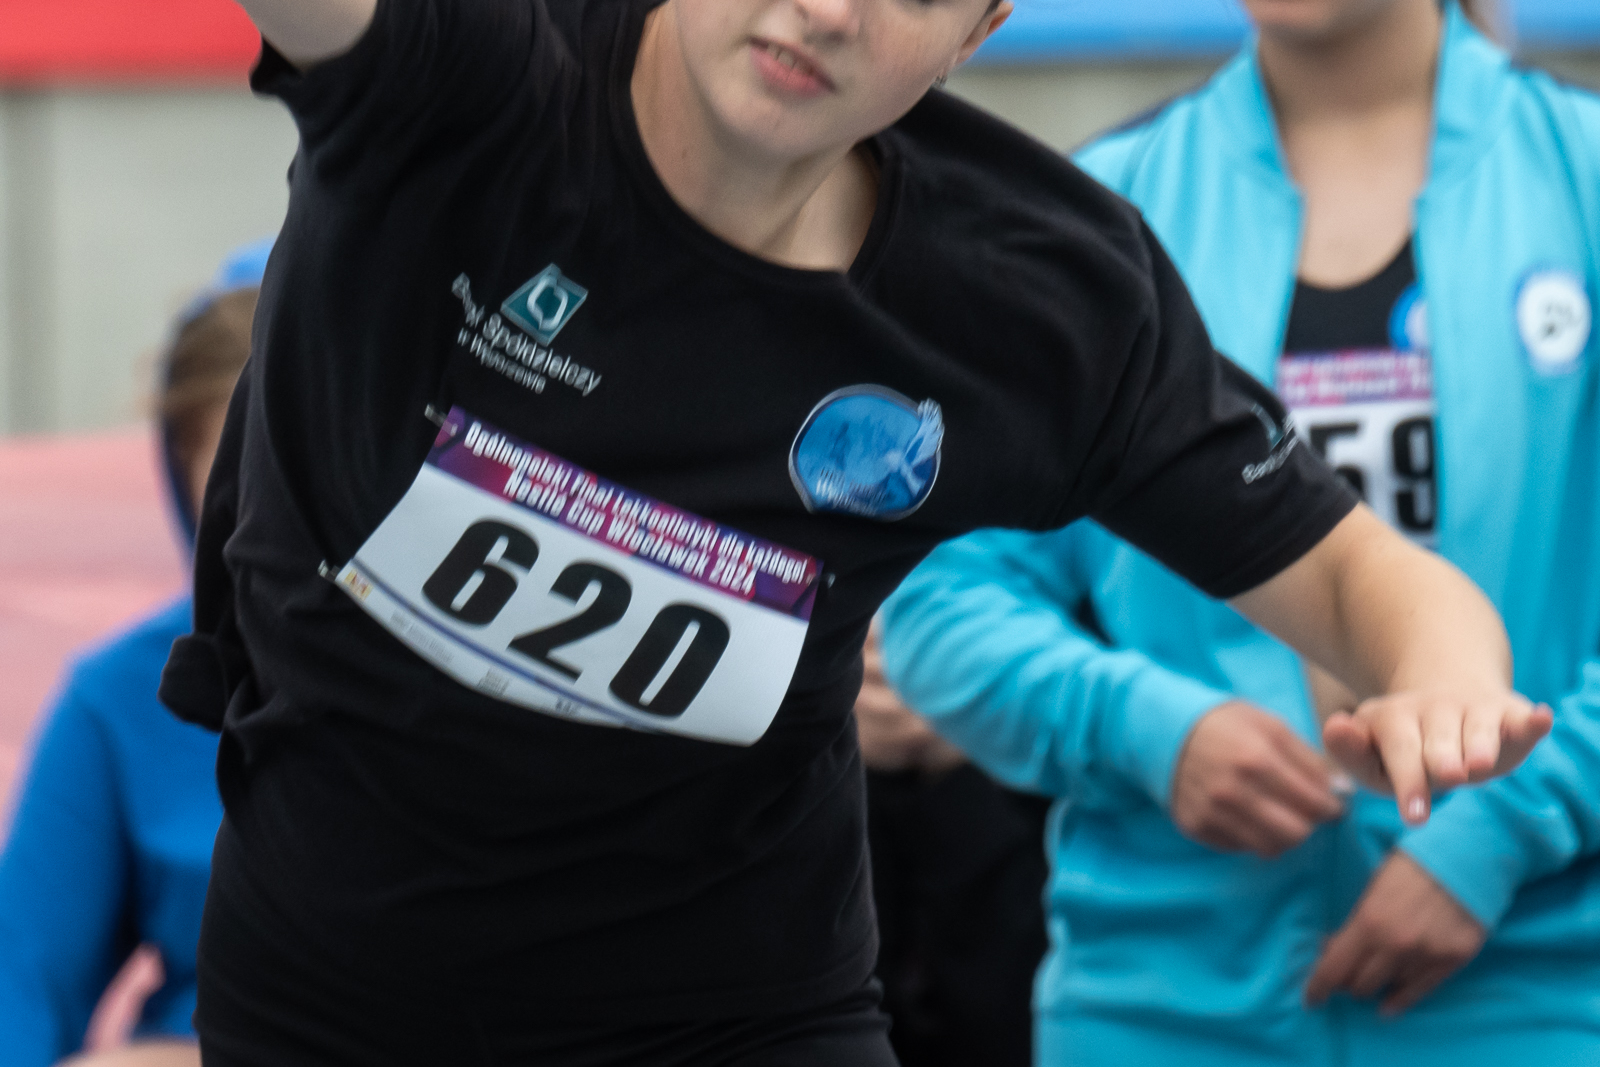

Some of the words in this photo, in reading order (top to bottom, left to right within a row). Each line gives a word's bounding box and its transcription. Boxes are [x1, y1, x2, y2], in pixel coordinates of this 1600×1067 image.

[421, 518, 731, 719] 620
[566, 497, 606, 536] Cup
[708, 555, 758, 595] 2024
